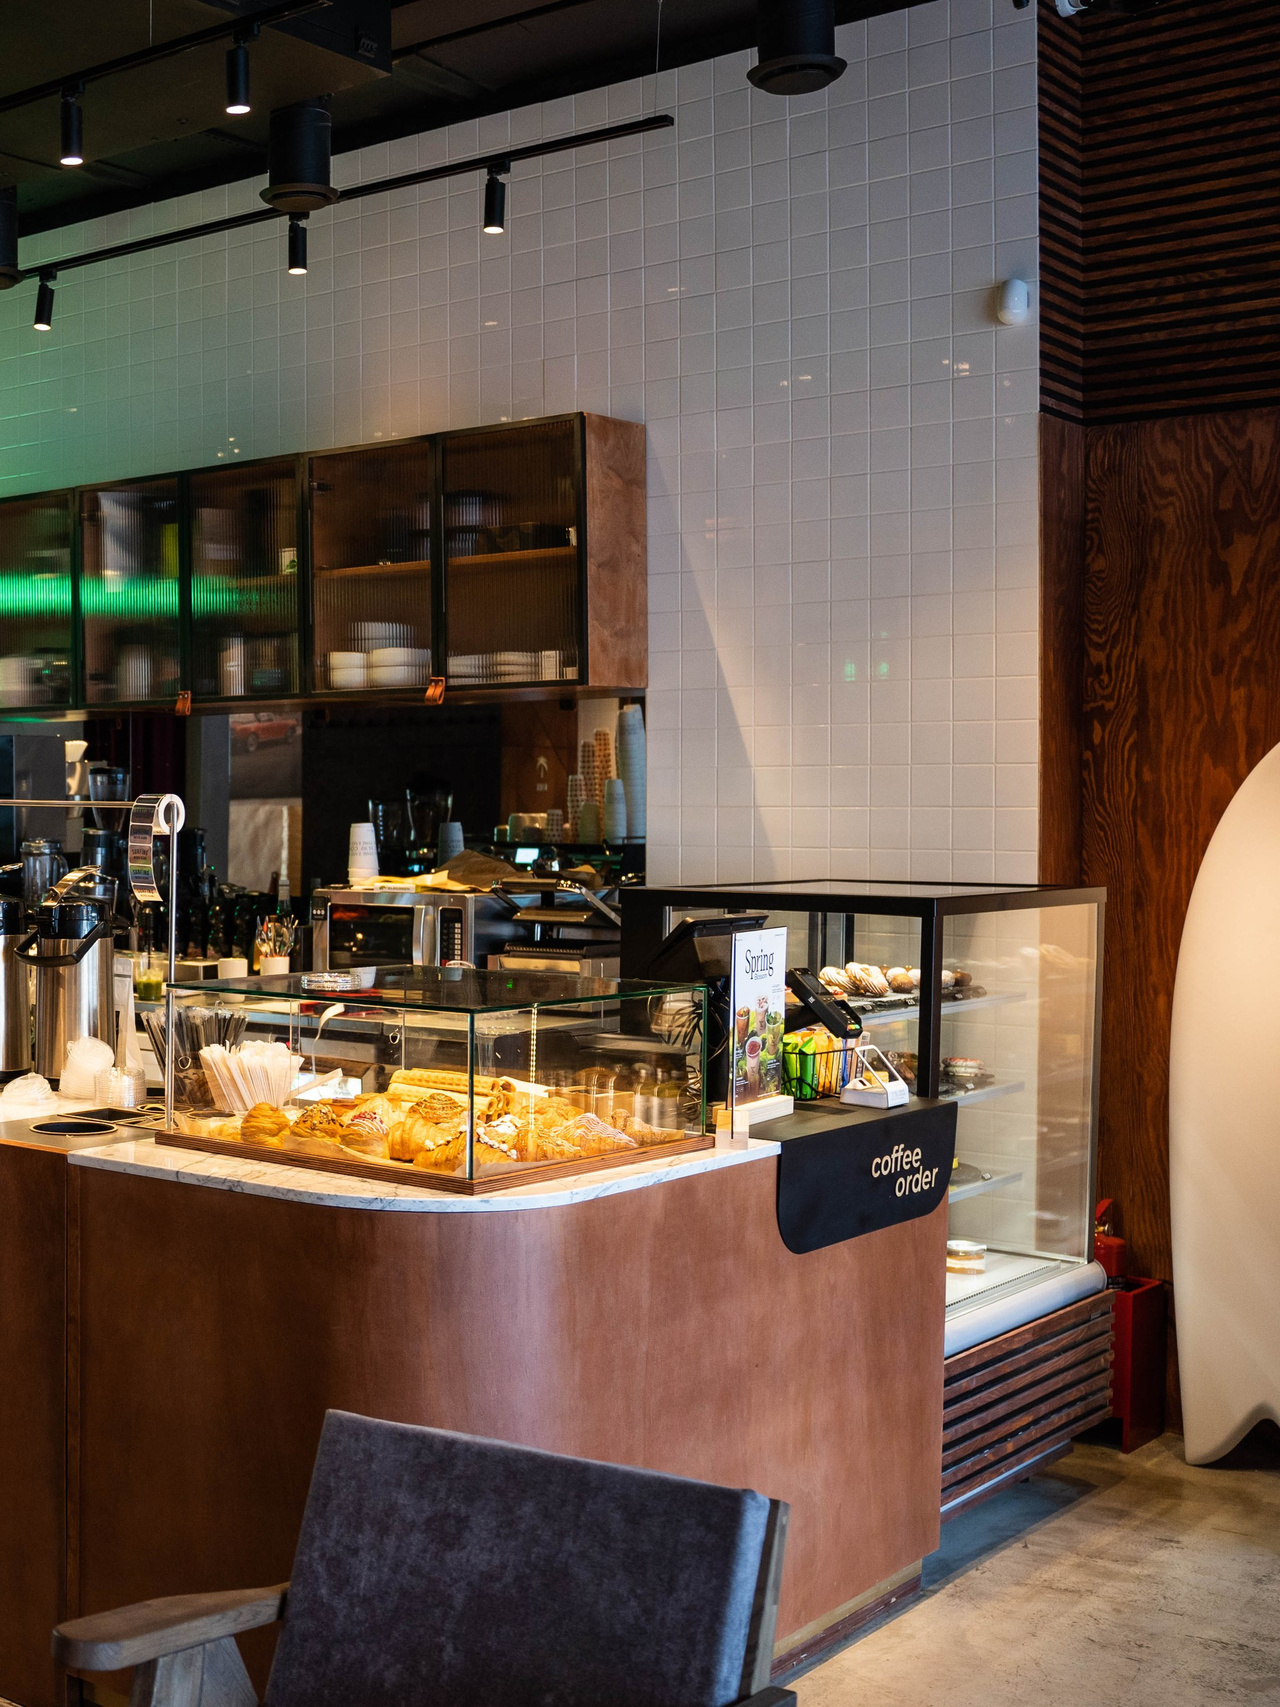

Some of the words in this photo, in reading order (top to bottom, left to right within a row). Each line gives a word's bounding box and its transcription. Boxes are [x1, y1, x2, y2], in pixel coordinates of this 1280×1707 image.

[745, 948, 775, 980] Spring
[871, 1143, 922, 1178] coffee
[895, 1165, 939, 1198] order
